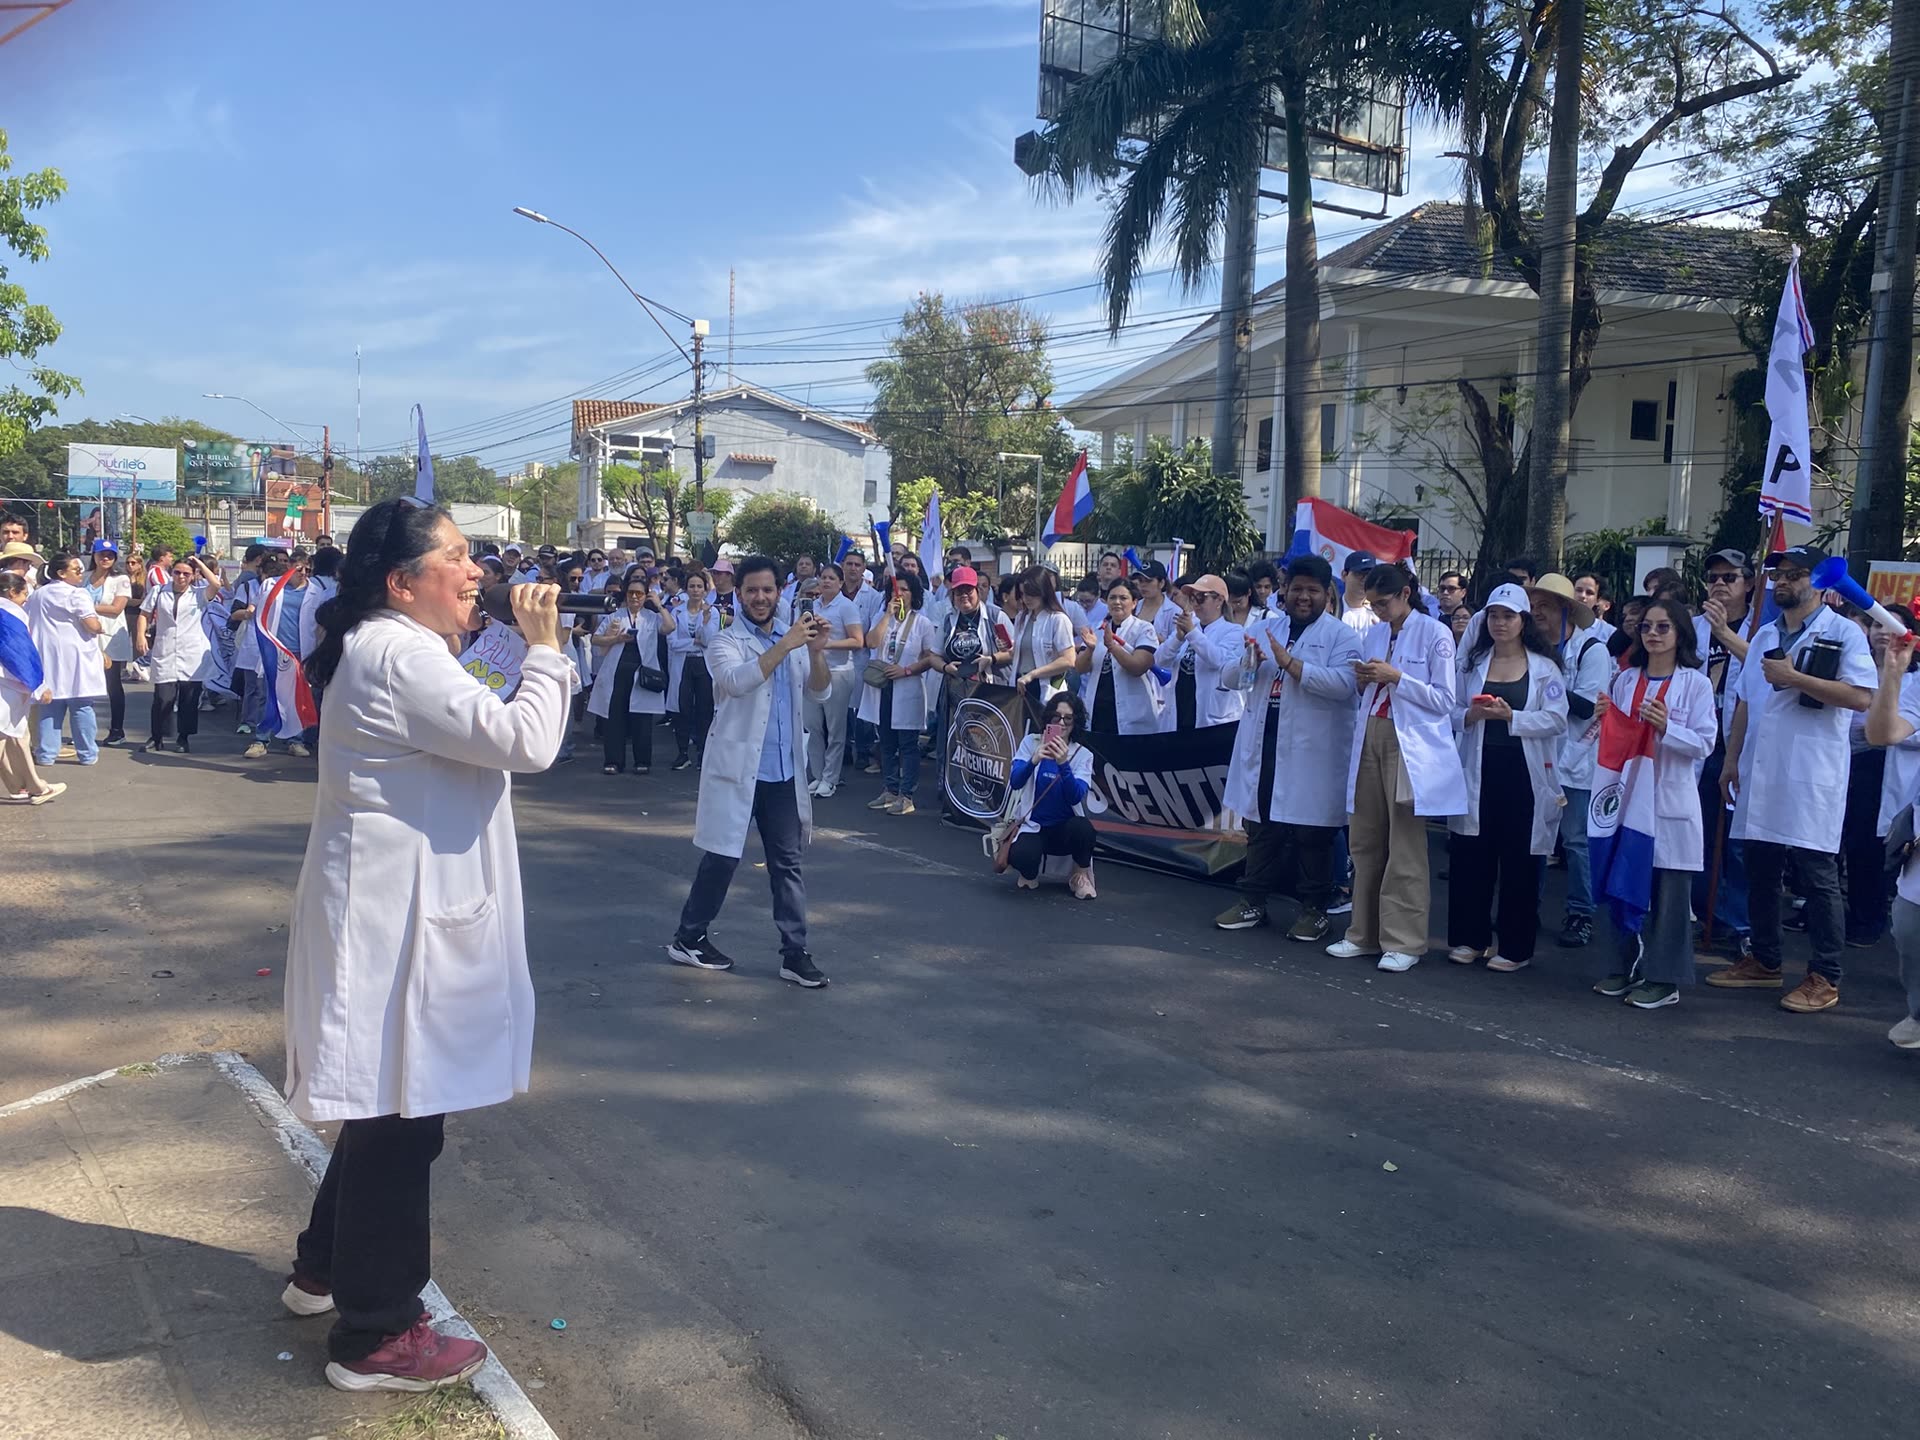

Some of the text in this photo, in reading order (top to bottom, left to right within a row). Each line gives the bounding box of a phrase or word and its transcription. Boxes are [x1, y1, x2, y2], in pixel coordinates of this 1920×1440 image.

[1869, 572, 1920, 603] INE
[499, 626, 510, 643] LA
[473, 634, 524, 676] SALUD
[463, 658, 507, 690] NO
